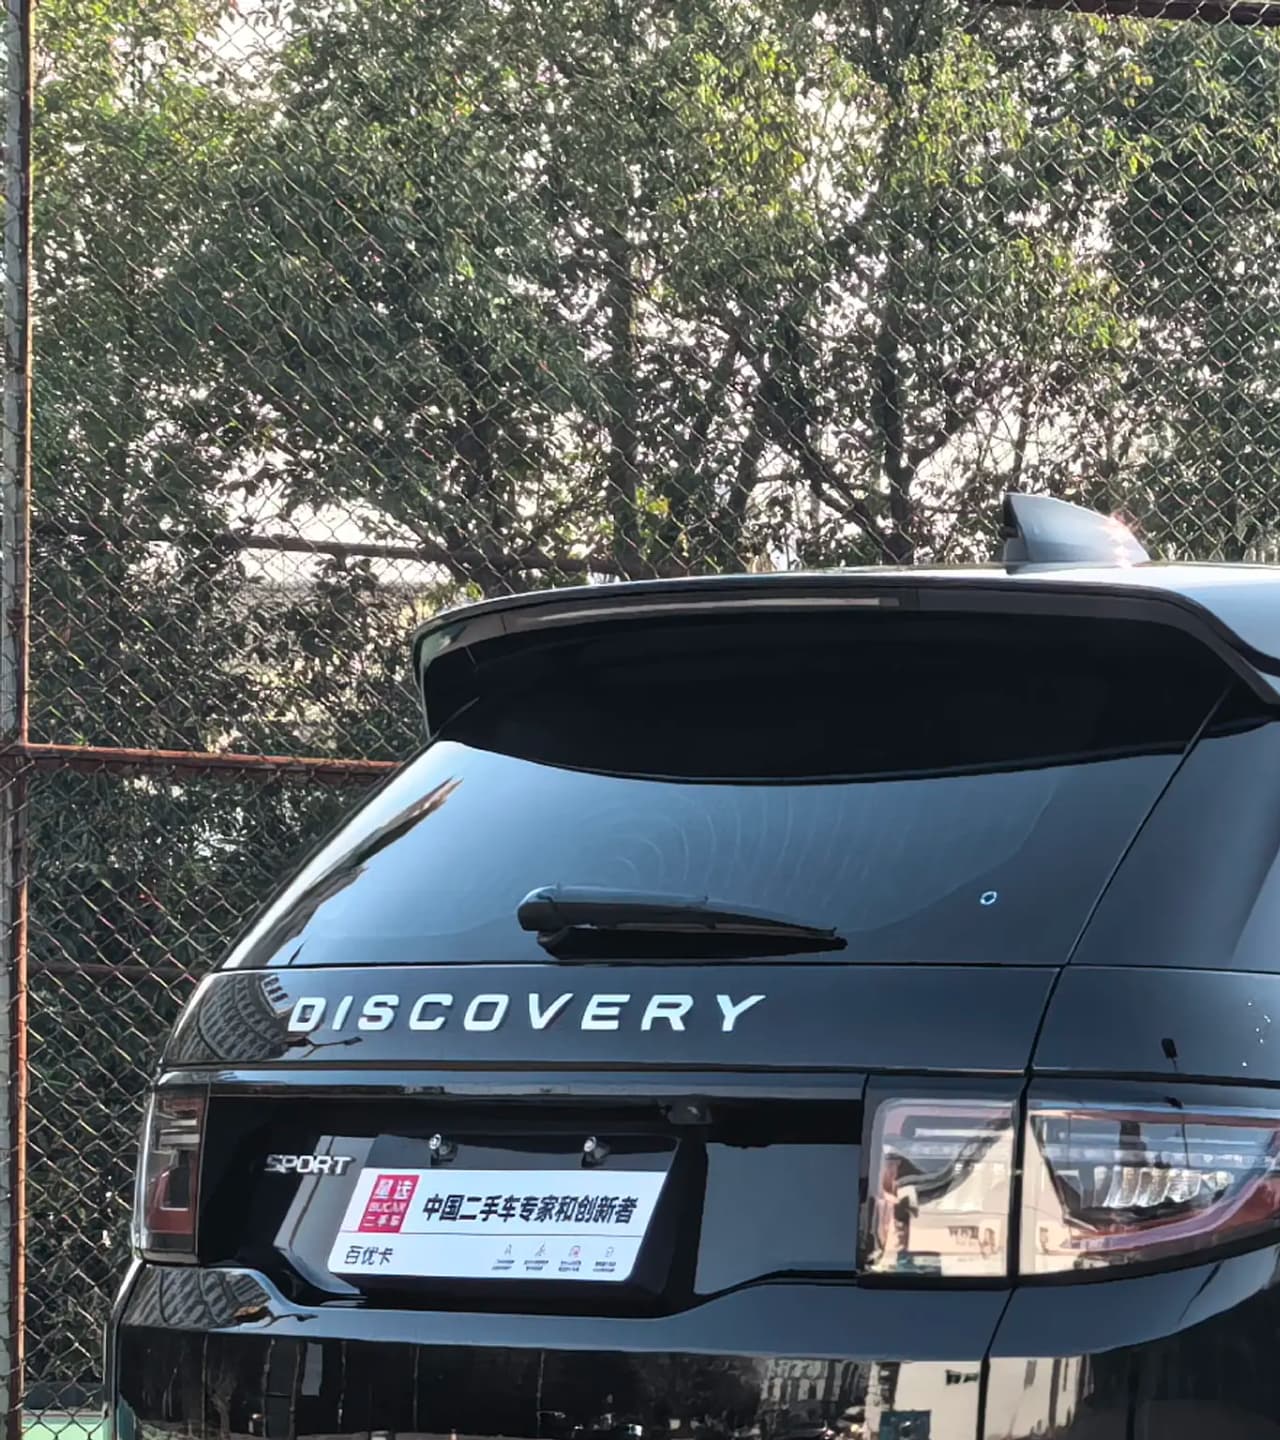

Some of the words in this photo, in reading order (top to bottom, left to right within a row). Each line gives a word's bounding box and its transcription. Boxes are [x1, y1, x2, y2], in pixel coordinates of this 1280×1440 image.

[288, 993, 766, 1031] DISCOVERY
[264, 1153, 353, 1175] SPORT
[422, 1193, 639, 1224] 中国二手车专家和创新者
[344, 1244, 394, 1266] 百优卡
